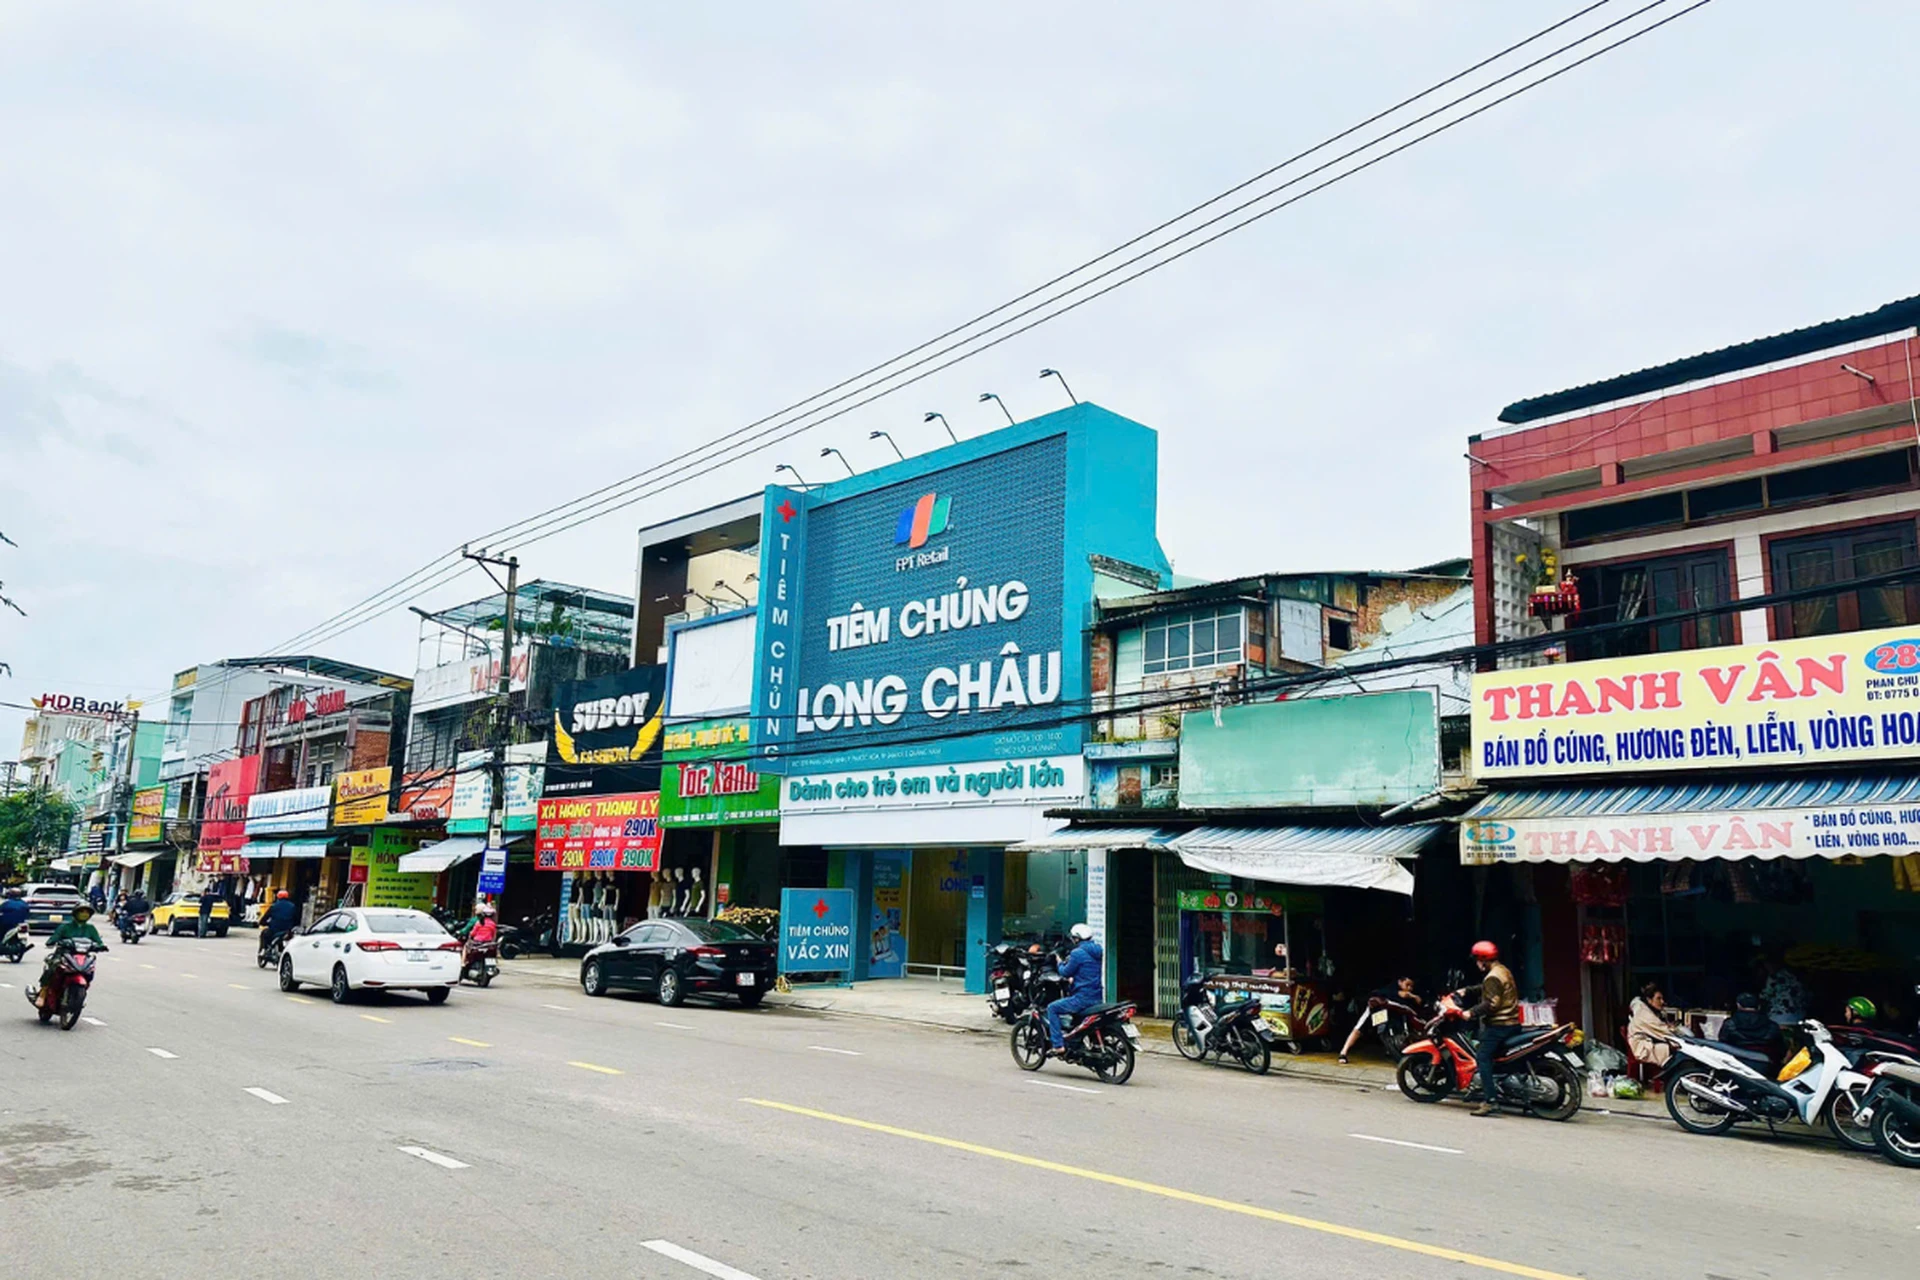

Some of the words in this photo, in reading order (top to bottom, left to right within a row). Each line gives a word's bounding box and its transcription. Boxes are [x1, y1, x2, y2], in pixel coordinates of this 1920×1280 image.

[896, 555, 915, 572] FPT
[917, 546, 949, 567] Retail
[772, 533, 790, 627] TIÊM
[827, 602, 890, 651] TIÊM
[900, 576, 1029, 637] CHỦNG
[1876, 644, 1920, 670] 28
[797, 675, 908, 733] LONG
[921, 641, 1061, 718] CHÂU
[1483, 671, 1682, 721] THANH
[1699, 650, 1847, 704] VÂN
[1866, 678, 1894, 689] PHAN
[1897, 675, 1918, 686] CHU
[1884, 689, 1909, 699] 0775
[571, 692, 649, 733] SUBOY
[764, 641, 785, 762] CHỦNG
[1484, 734, 1519, 767] BÁN
[1524, 728, 1548, 765] ĐỒ
[1554, 729, 1611, 765] CÚNG,
[1616, 727, 1685, 761] HƯƠNG
[1690, 720, 1740, 758] ĐÈN,
[1746, 711, 1804, 755] LIỄN,
[1809, 710, 1874, 750] VÒNG
[790, 777, 833, 801] Dành
[835, 777, 869, 799] cho
[872, 770, 898, 797] trẻ
[900, 774, 931, 796] em
[935, 766, 960, 793] và
[965, 761, 1024, 797] người
[1029, 759, 1065, 788] lớn
[596, 800, 638, 816] THANH
[641, 796, 660, 815] LÝ
[1860, 809, 1897, 826] CÚNG,
[624, 819, 657, 836] 290K
[1524, 827, 1674, 855] THANH
[1687, 816, 1793, 850] VÂN
[1847, 830, 1880, 847] VÒNG
[1883, 831, 1920, 846] HOA...
[561, 849, 585, 867] 290K
[622, 848, 654, 867] 390K
[789, 924, 811, 937] TIÊM
[813, 923, 850, 937] CHỦNG
[788, 938, 820, 960] VẮC
[823, 943, 849, 959] XIN
